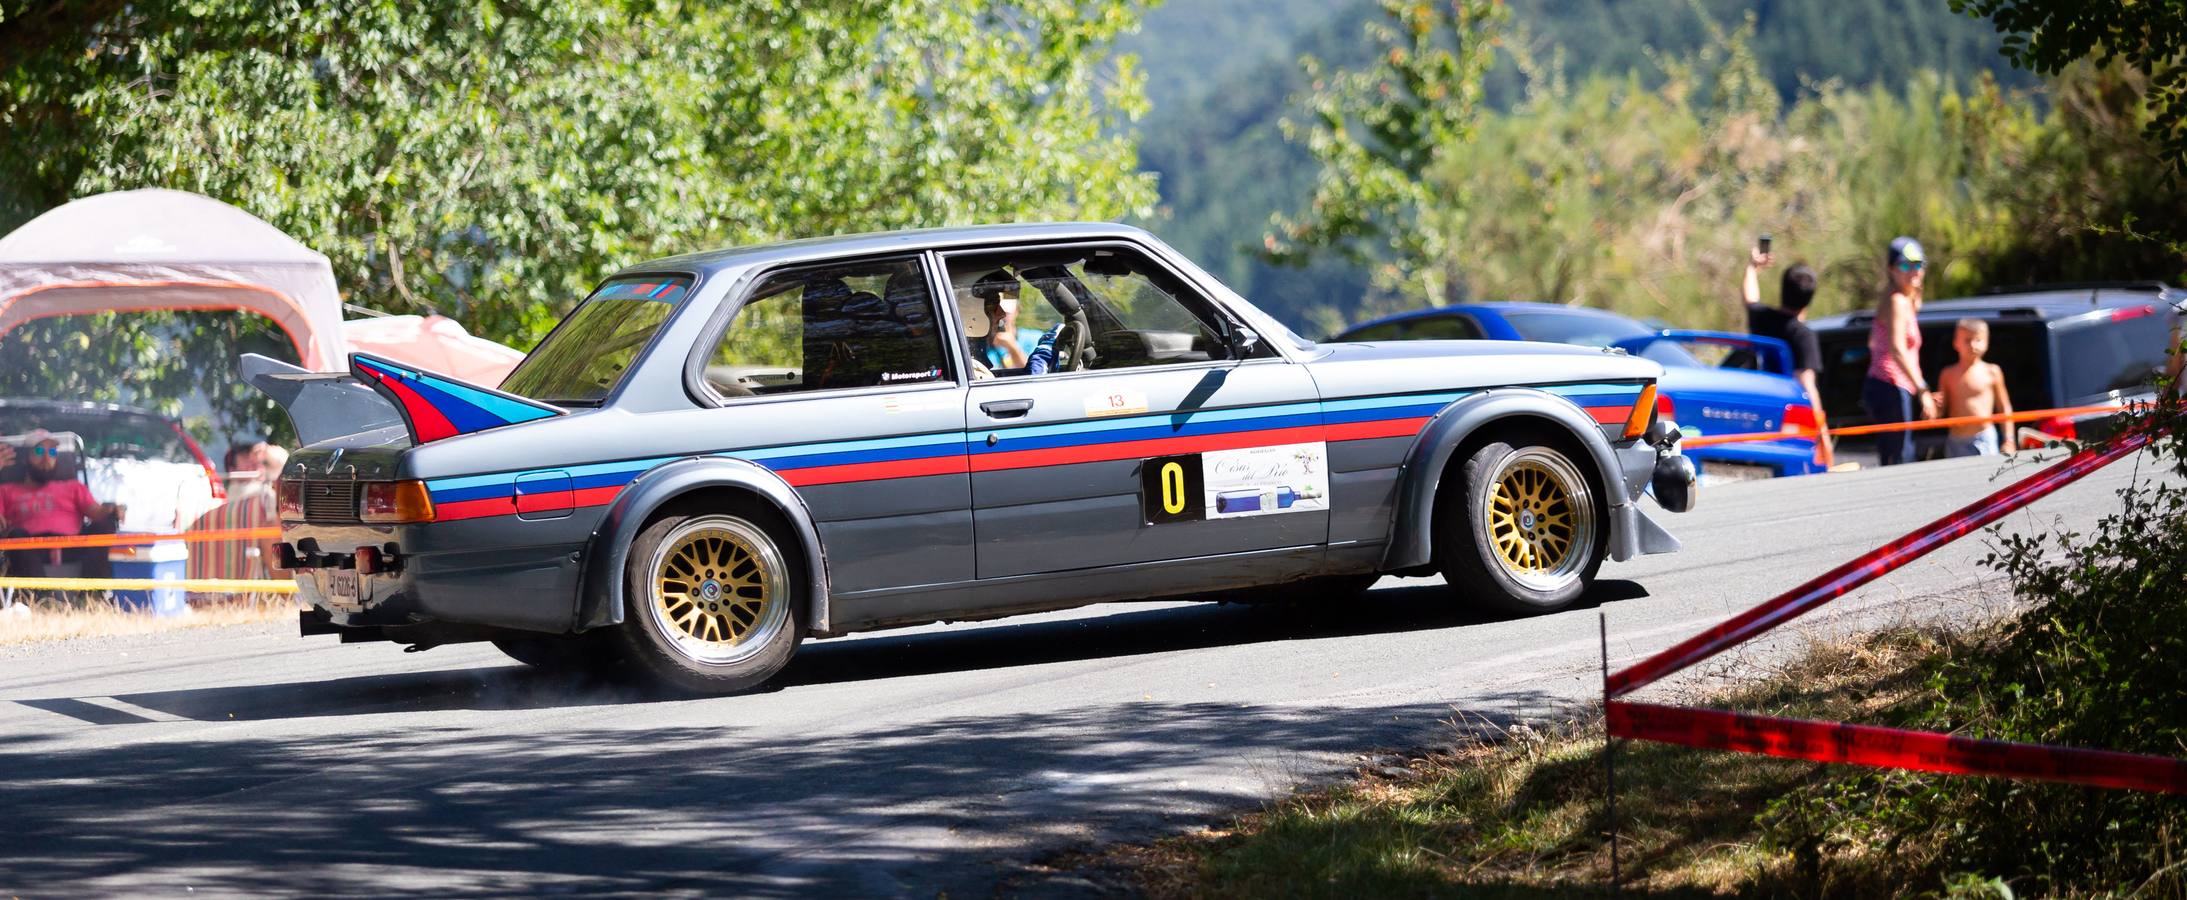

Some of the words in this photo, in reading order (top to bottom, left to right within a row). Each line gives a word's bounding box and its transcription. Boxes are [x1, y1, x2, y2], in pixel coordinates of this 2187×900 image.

[891, 370, 931, 380] Motorsport
[1107, 394, 1125, 408] 13
[1161, 461, 1184, 514] 0
